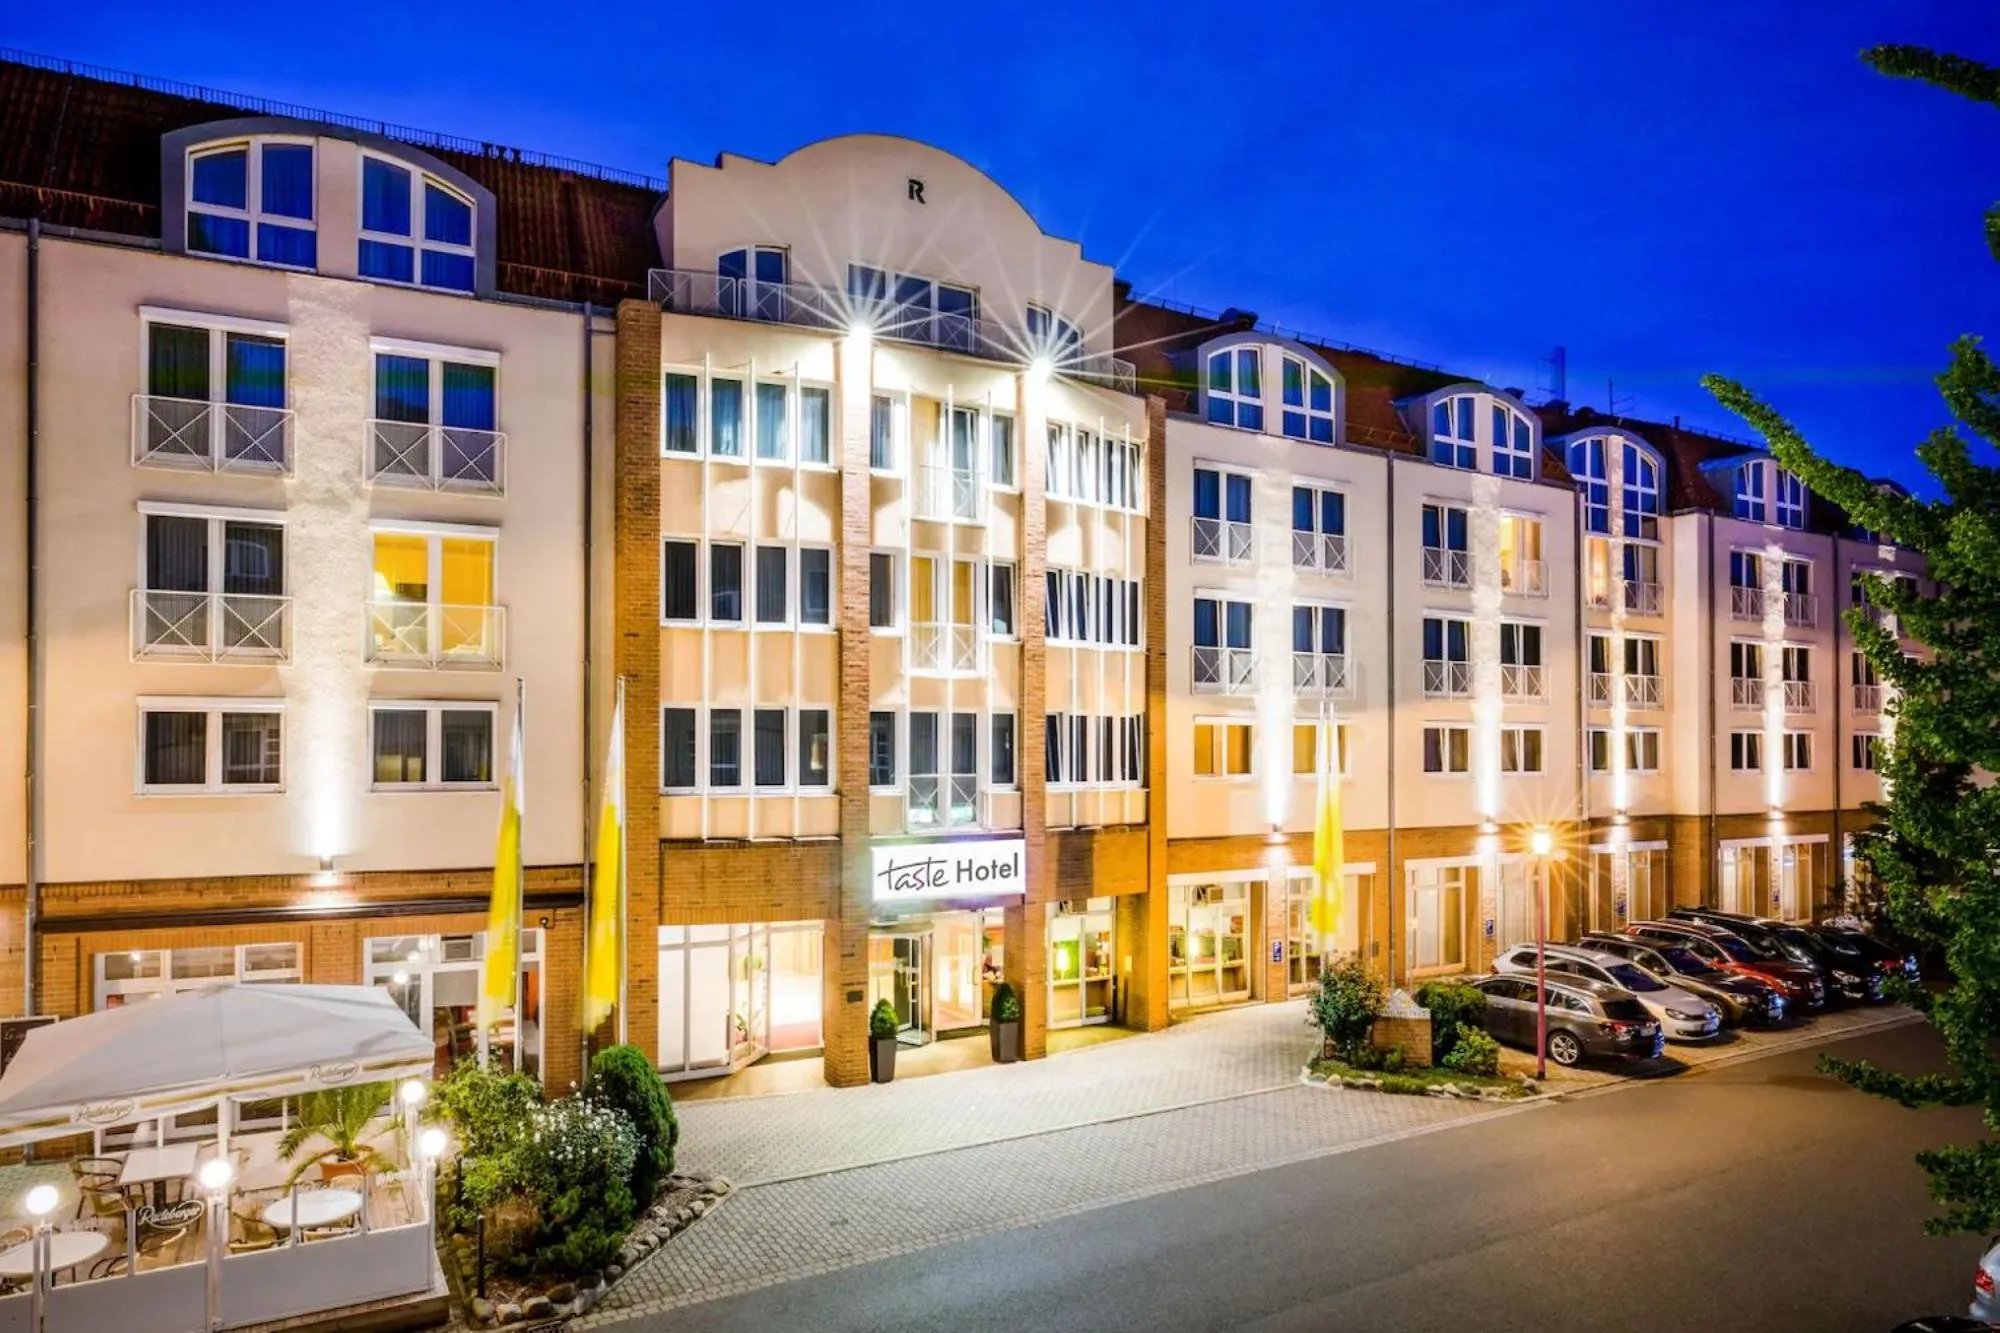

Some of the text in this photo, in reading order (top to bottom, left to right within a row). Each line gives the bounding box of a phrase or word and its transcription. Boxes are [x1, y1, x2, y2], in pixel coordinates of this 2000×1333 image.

[908, 178, 926, 205] R
[877, 852, 1019, 891] taste Hotel
